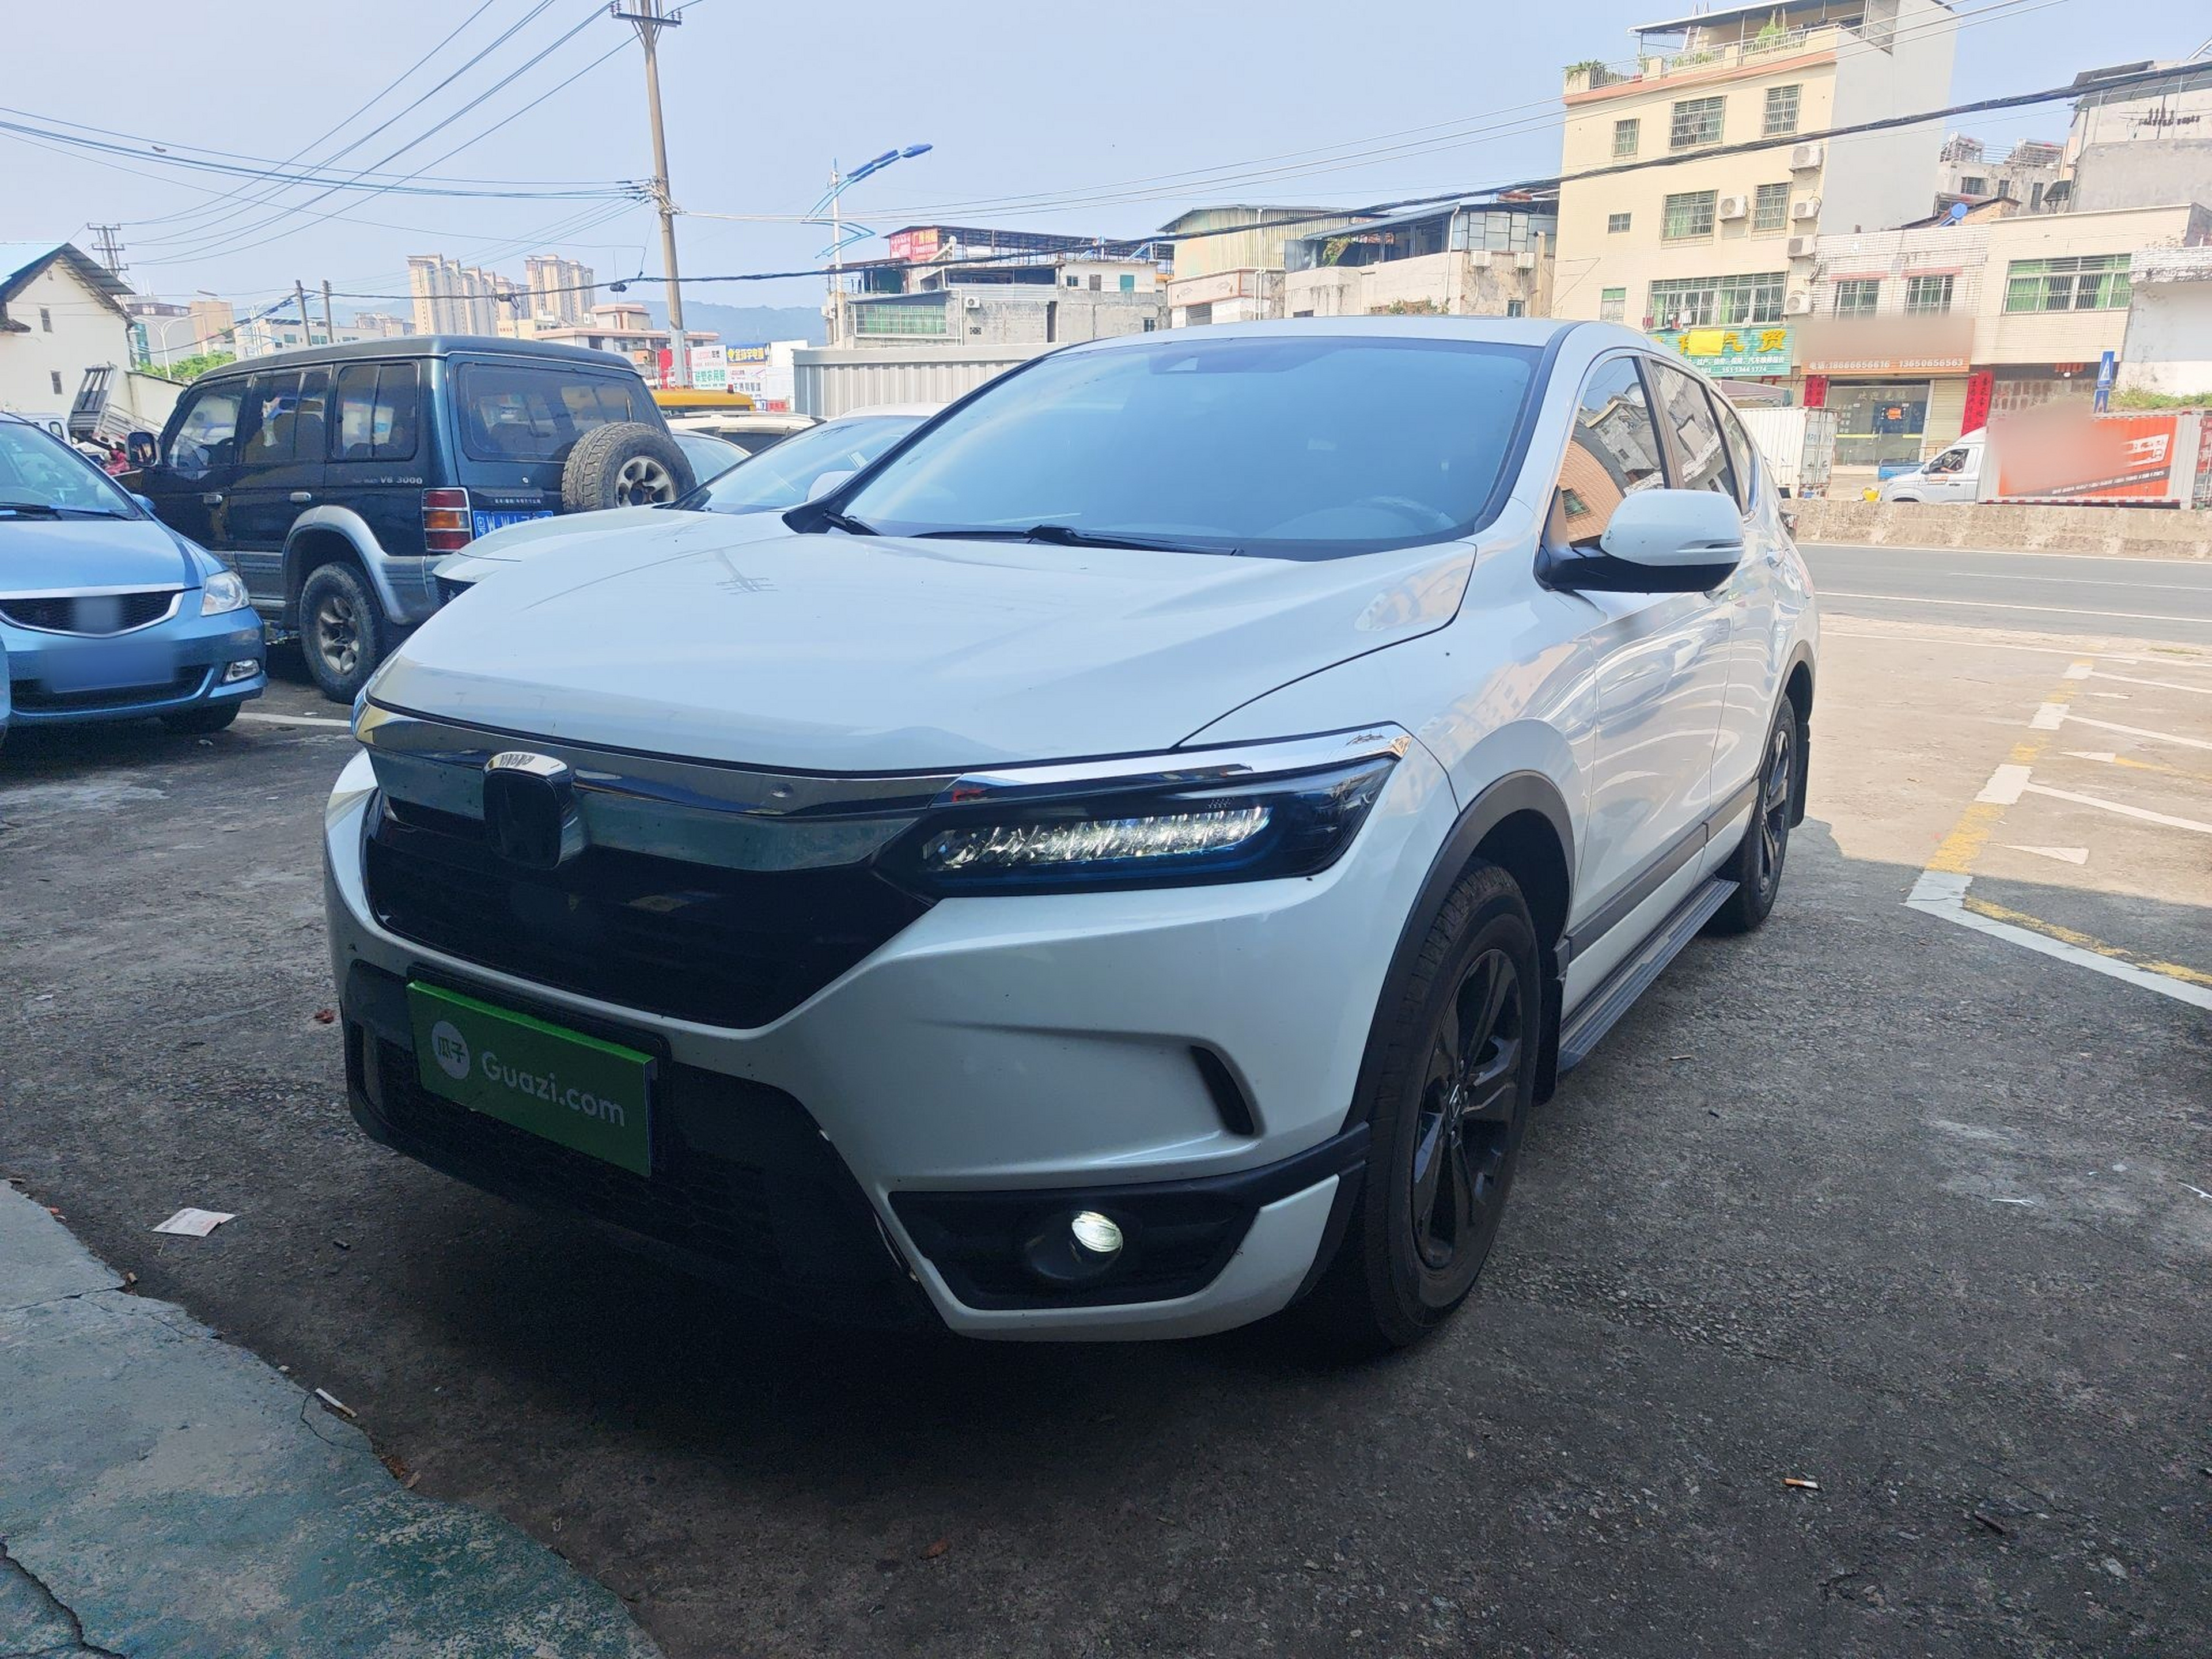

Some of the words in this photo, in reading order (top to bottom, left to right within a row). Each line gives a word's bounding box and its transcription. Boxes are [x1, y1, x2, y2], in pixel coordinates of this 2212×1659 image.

[396, 476, 423, 484] 3000
[438, 1036, 466, 1064] 瓜子
[482, 1051, 625, 1127] Guazi.com
